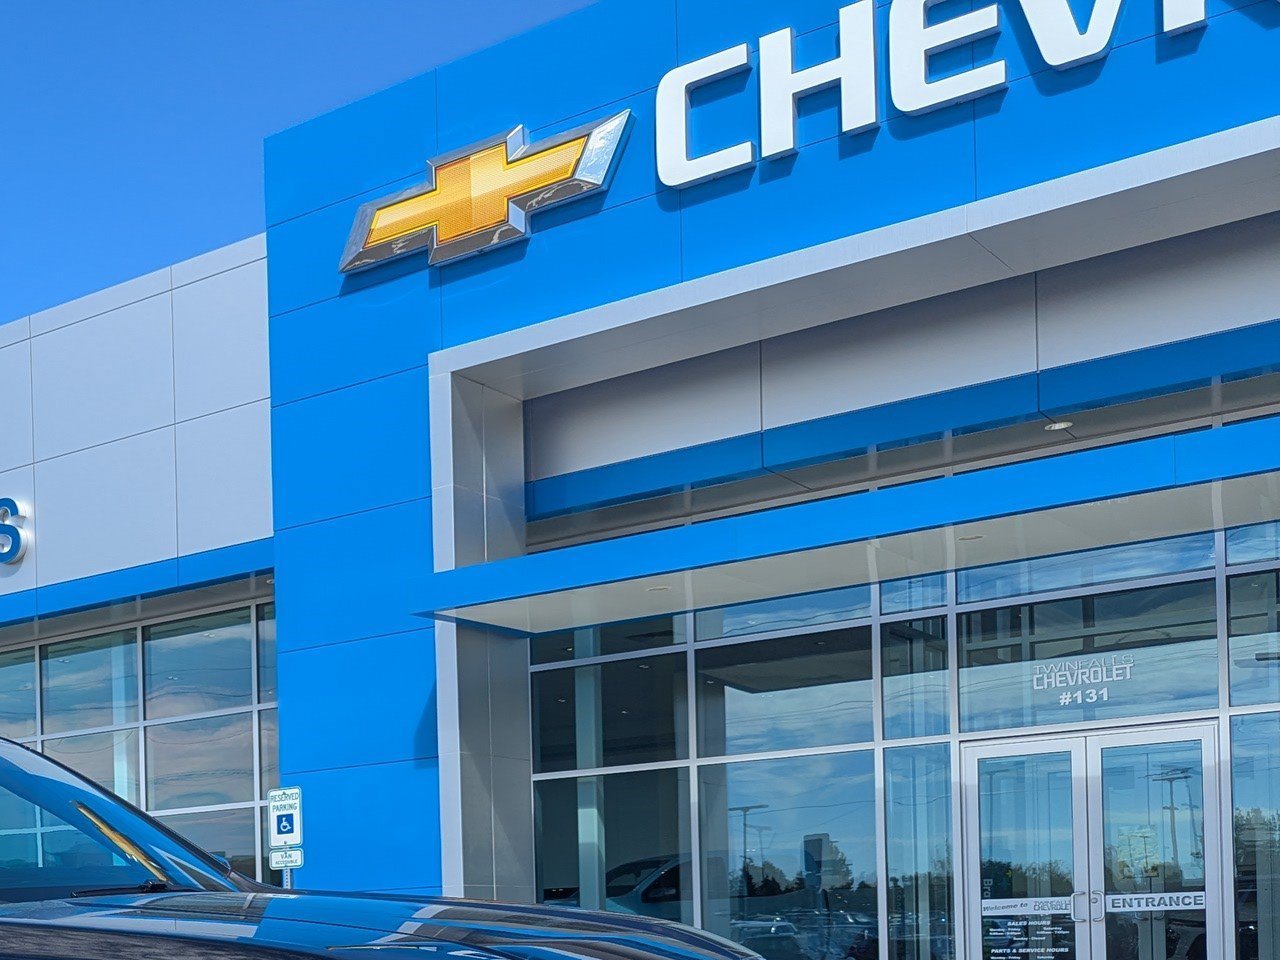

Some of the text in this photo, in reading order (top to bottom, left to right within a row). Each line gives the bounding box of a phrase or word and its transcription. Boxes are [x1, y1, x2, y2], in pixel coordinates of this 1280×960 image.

[1033, 663, 1135, 690] CHEVROLET
[1060, 687, 1109, 705] #131
[271, 792, 299, 802] RESERVED
[272, 803, 298, 812] PARKING
[983, 904, 1018, 912] Welcome
[1111, 895, 1204, 909] ENTRANCE
